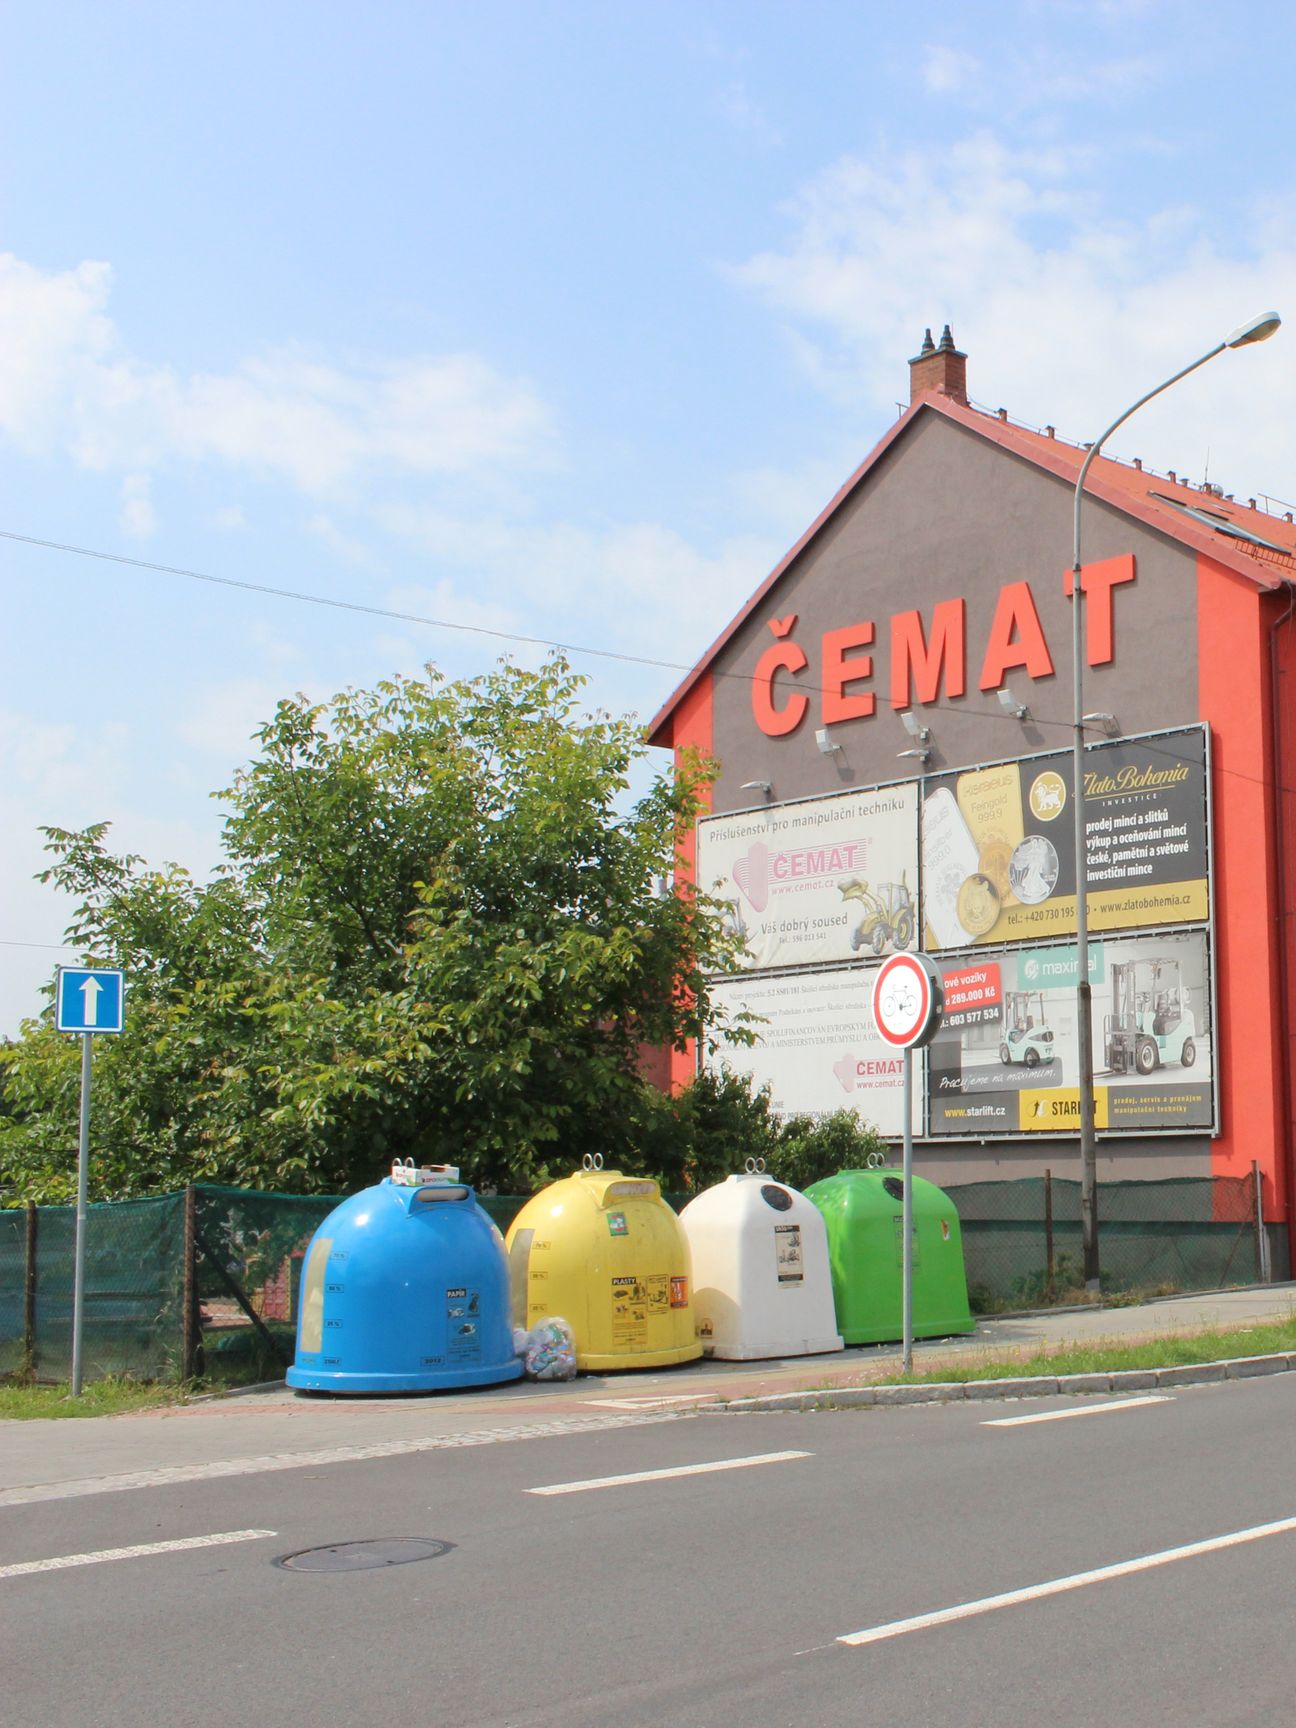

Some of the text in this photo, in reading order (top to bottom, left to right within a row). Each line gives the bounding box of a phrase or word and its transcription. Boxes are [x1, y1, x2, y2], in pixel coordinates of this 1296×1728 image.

[751, 553, 1136, 737] ČEMAT
[971, 794, 1007, 812] Feingold
[1102, 793, 1158, 806] INVESTICE
[710, 799, 905, 842] Příslušenství pro manipulační techniku
[1086, 808, 1168, 834] prodej mincí a slitků
[1086, 823, 1187, 851] výkup a oceňování mincí
[773, 844, 858, 879] ČEMAT
[1087, 840, 1189, 865] české, pamětní a světové
[1087, 863, 1153, 881] investiční mince
[771, 879, 835, 895] www.cemat.cz
[1008, 912, 1023, 924] tel.:
[1024, 910, 1043, 922] +420
[1045, 908, 1059, 920] 730
[1061, 906, 1074, 918] 195
[1100, 894, 1191, 913] www.zlatobohemia.cz
[761, 912, 848, 935] Váš dobrý soused
[1042, 953, 1097, 976] maxial
[944, 971, 987, 989] ové vozíky
[951, 988, 983, 1004] 289.000
[985, 986, 995, 998] Kč
[950, 1014, 965, 1026] 603
[966, 1011, 982, 1023] 577
[983, 1008, 999, 1020] 534
[939, 1068, 1056, 1093] Pracujeme na maximum.
[944, 1104, 1006, 1118] www.starlift.cz
